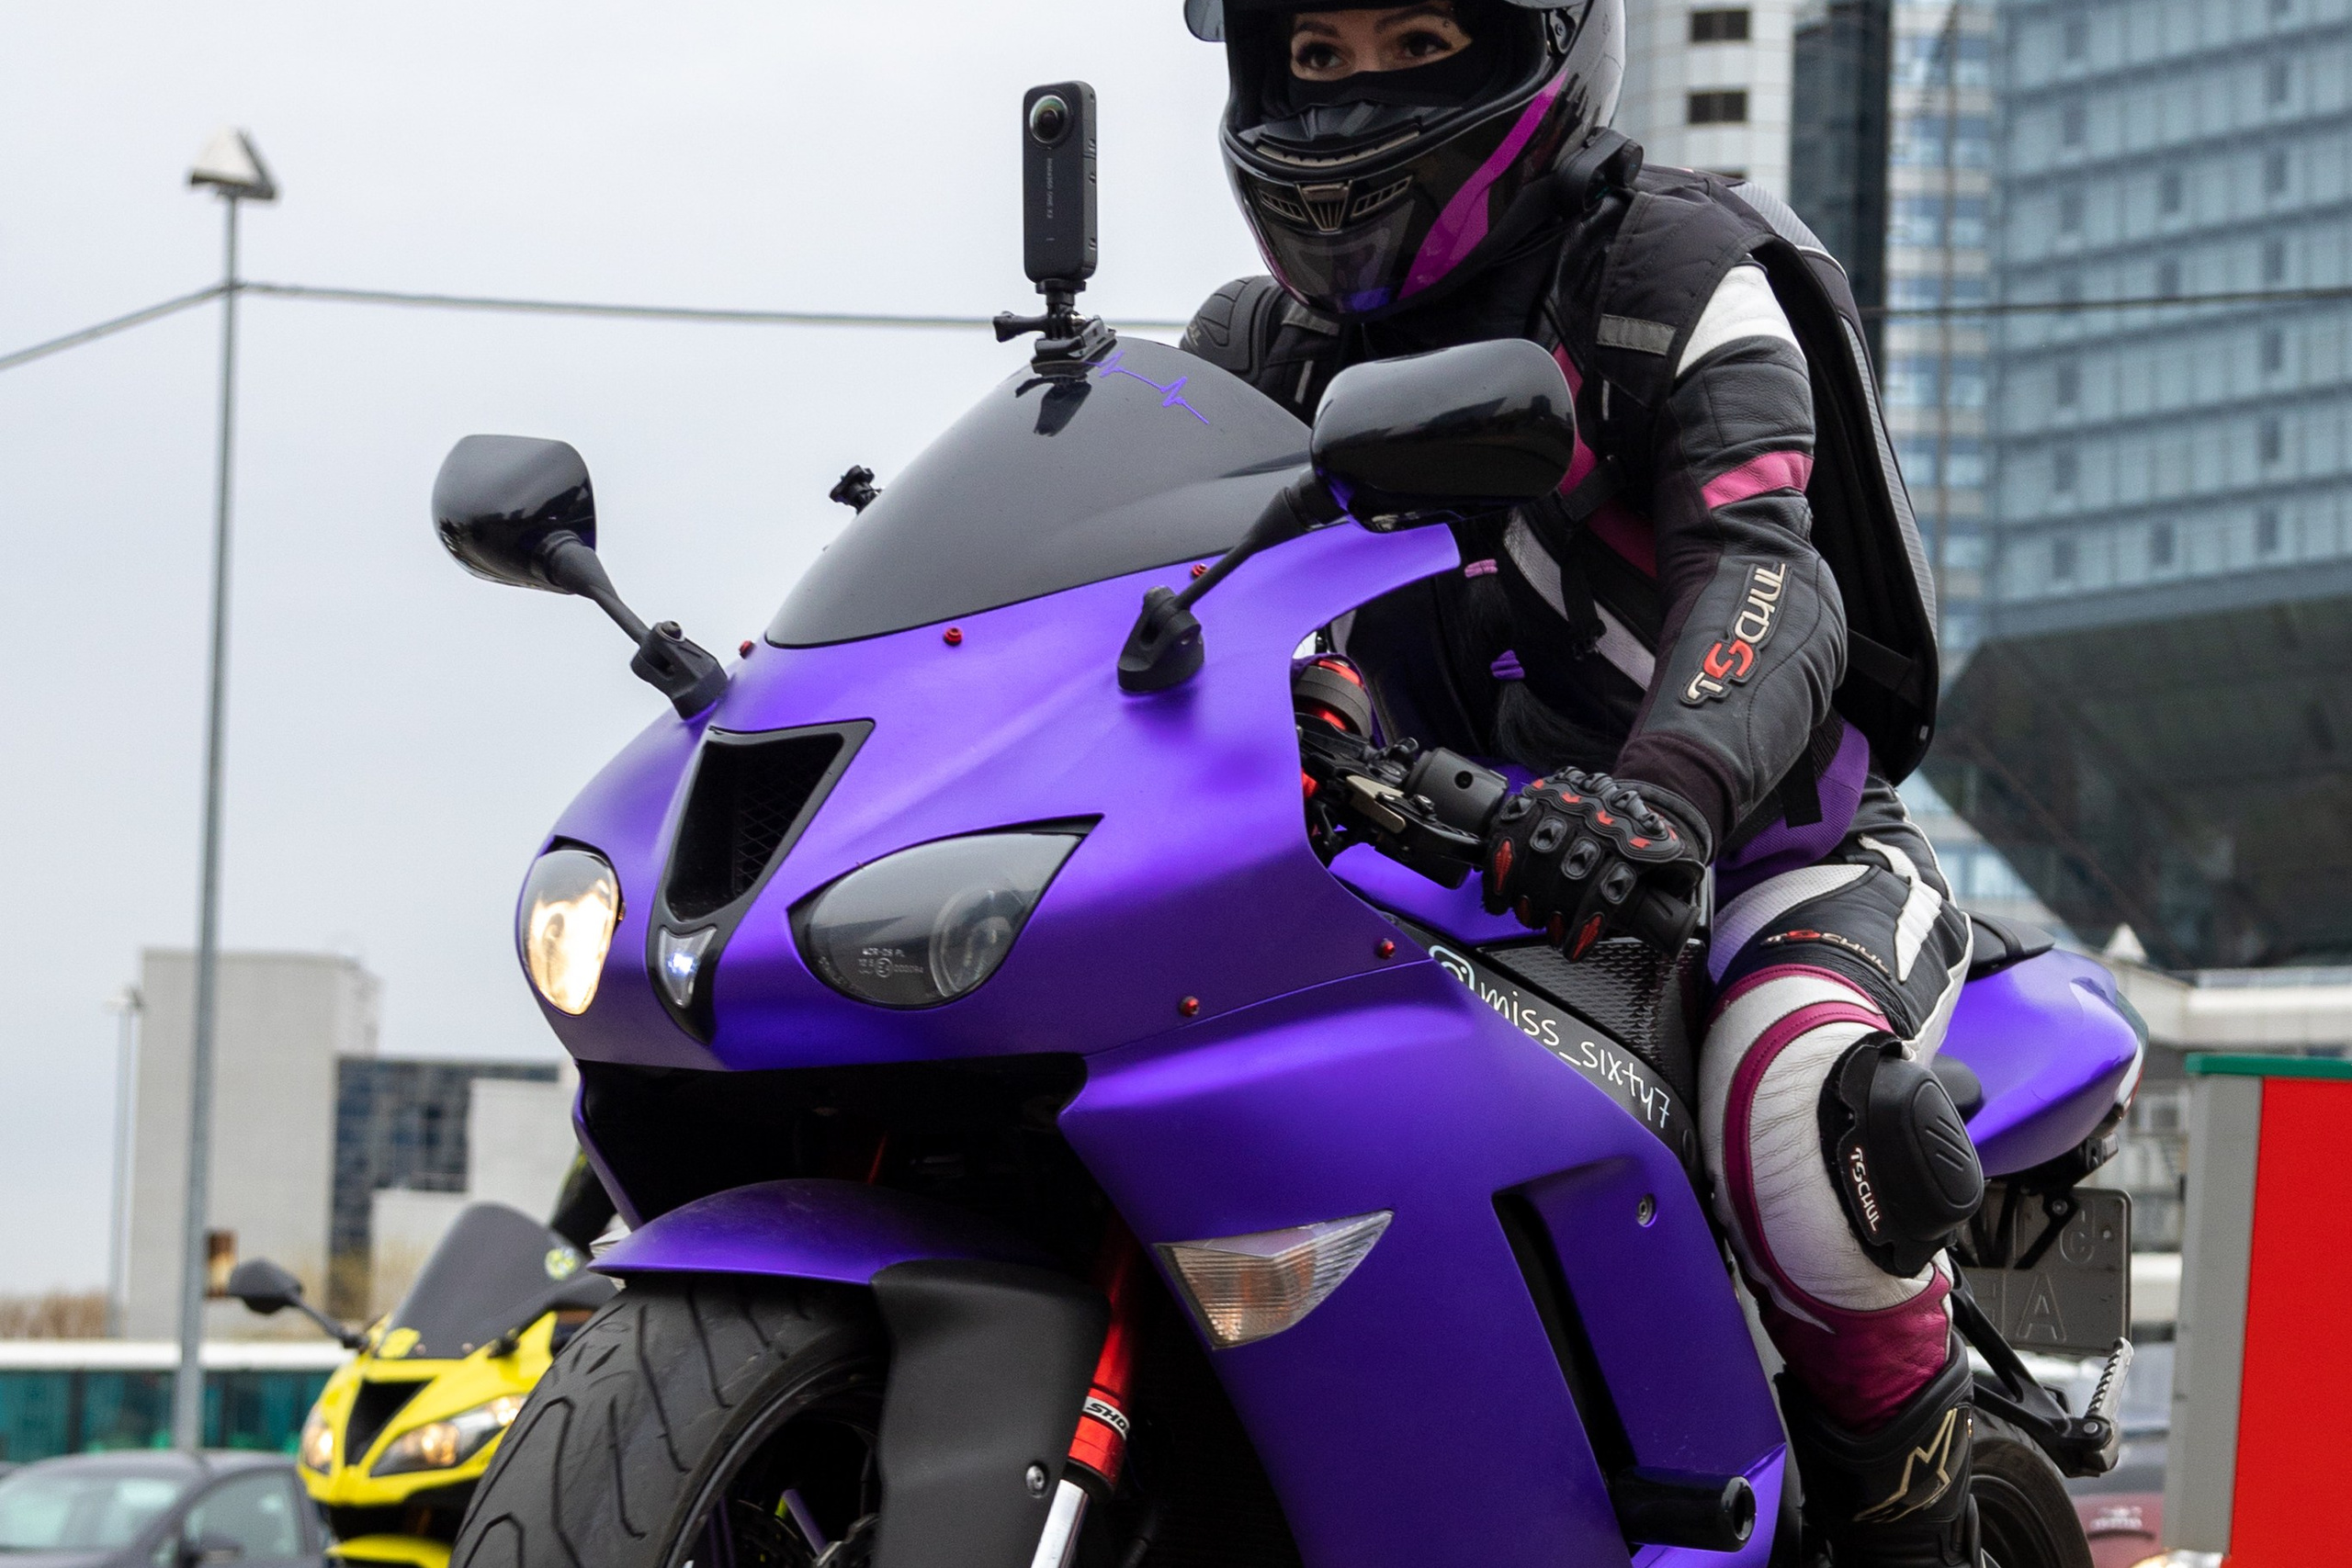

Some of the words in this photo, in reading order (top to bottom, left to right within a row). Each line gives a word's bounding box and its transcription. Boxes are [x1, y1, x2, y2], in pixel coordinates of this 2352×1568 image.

[1686, 562, 1786, 700] TSCHUL
[1850, 1146, 1880, 1232] TSCHUL
[1086, 1402, 1130, 1434] SHO
